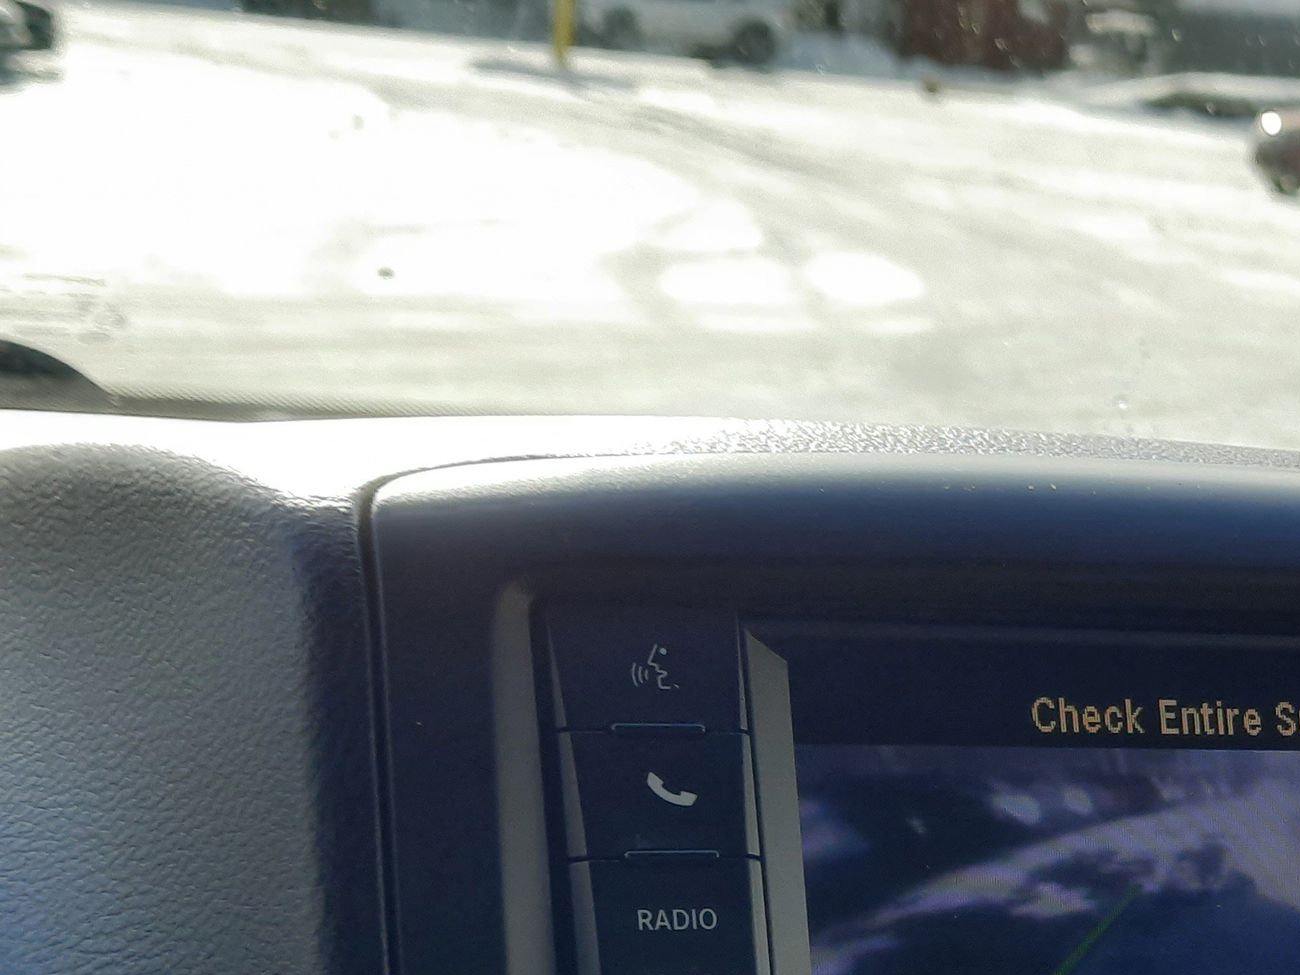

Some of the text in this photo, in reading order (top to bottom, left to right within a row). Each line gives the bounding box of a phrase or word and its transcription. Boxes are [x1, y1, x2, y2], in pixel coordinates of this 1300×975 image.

[1031, 696, 1145, 735] Check
[1158, 698, 1262, 738] Entire
[637, 908, 718, 932] RADIO
